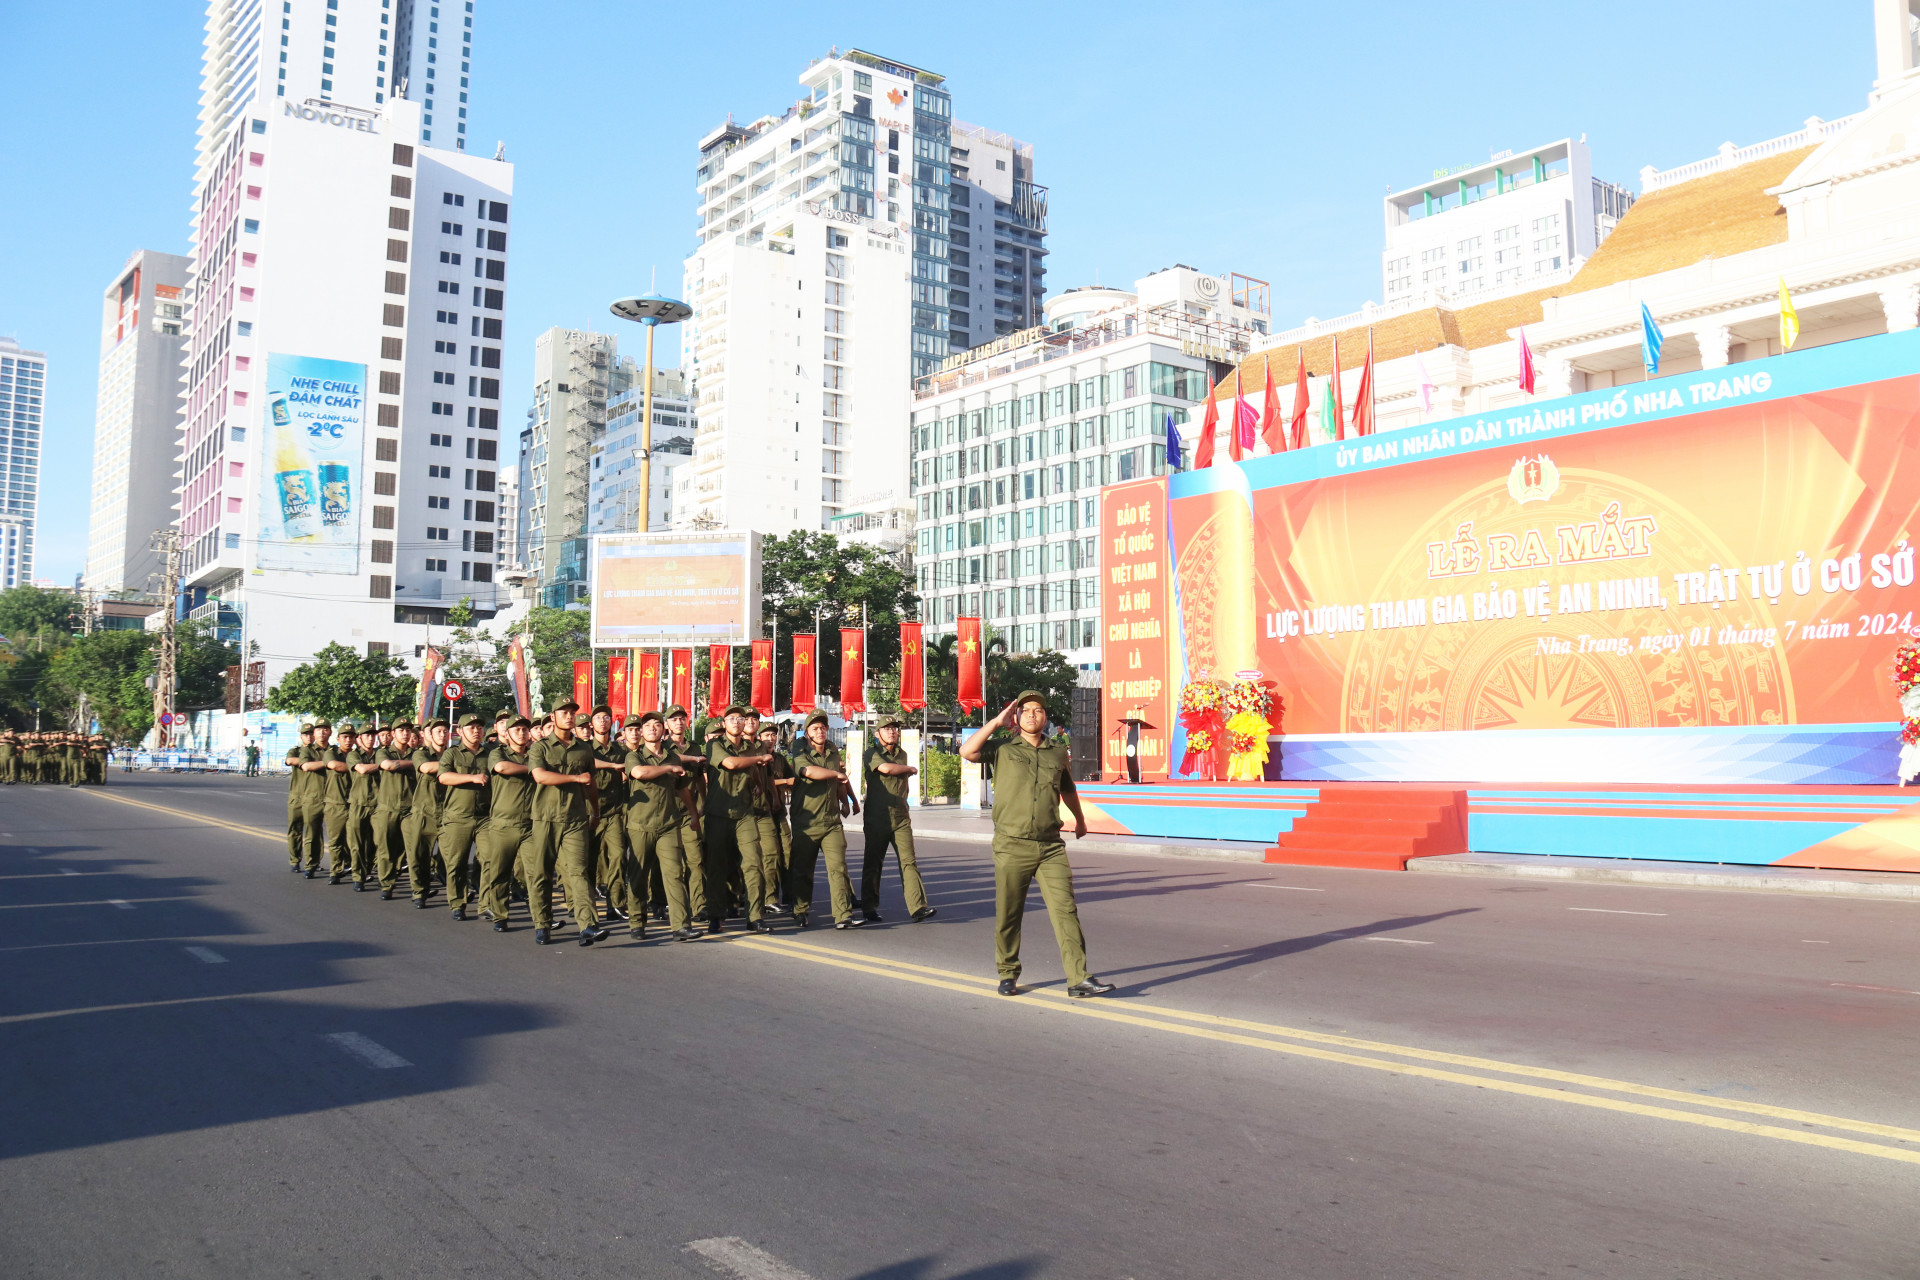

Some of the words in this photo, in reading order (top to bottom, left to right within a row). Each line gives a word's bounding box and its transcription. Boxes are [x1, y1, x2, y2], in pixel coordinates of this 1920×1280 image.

[284, 100, 380, 135] NOVOTEL
[878, 116, 910, 134] MAPLE
[1434, 168, 1449, 179] ibis
[826, 207, 859, 224] BOSS
[942, 349, 973, 371] HAPPY
[975, 338, 1005, 359] LIGHT
[1008, 326, 1041, 349] HOTEL
[1183, 339, 1226, 363] HAPPY
[291, 377, 320, 392] NHẸ
[323, 380, 359, 395] CHILL
[289, 390, 322, 406] ĐẬM
[325, 394, 362, 409] CHẤT
[1336, 445, 1358, 468] ỦY
[1362, 441, 1398, 464] BAN
[1403, 428, 1455, 456] NHÂN
[1460, 419, 1502, 446] DÂN
[1506, 409, 1576, 437] THÀNH
[1581, 389, 1628, 424] PHỐ
[1633, 388, 1684, 415] NHA
[1689, 371, 1772, 404] TRANG
[1117, 502, 1137, 527] BẢO
[1138, 500, 1151, 526] VỆ
[1113, 530, 1126, 556] TỔ
[1128, 527, 1155, 556] QUỐC
[1427, 520, 1482, 579] LỄ
[1487, 529, 1552, 573] RA
[1557, 500, 1659, 566] MẮT
[1111, 562, 1132, 587] VIỆT
[1133, 561, 1157, 581] NAM
[1118, 590, 1132, 612] XÃ
[1133, 588, 1151, 613] HỘI
[1266, 608, 1300, 643] LỰC
[1303, 603, 1365, 639] LƯỢNG
[1371, 598, 1426, 631] THAM
[1432, 594, 1468, 625] GIA
[1473, 581, 1517, 622] BẢO
[1523, 579, 1551, 623] VỆ
[1558, 582, 1592, 615] AN
[1599, 575, 1668, 611] NINH,
[1674, 562, 1740, 610] TRẬT
[1746, 560, 1785, 605] TỰ
[1791, 550, 1812, 597] Ở
[1820, 552, 1862, 594] CƠ
[1871, 539, 1915, 590] SỞ
[1109, 617, 1129, 641] CHỦ
[1130, 617, 1161, 640] NGHĨA
[1535, 636, 1571, 656] Nha
[1577, 634, 1634, 657] Trang,
[1639, 628, 1685, 656] ngày
[1689, 626, 1711, 647] 01
[1718, 623, 1777, 648] tháng
[1784, 620, 1797, 641] 7
[1801, 618, 1850, 640] năm
[1856, 611, 1913, 637] 2024
[1129, 647, 1142, 669] LÀ
[1110, 679, 1125, 703] SỰ
[1125, 676, 1162, 701] NGHIỆP
[1109, 735, 1127, 757] TOÀ
